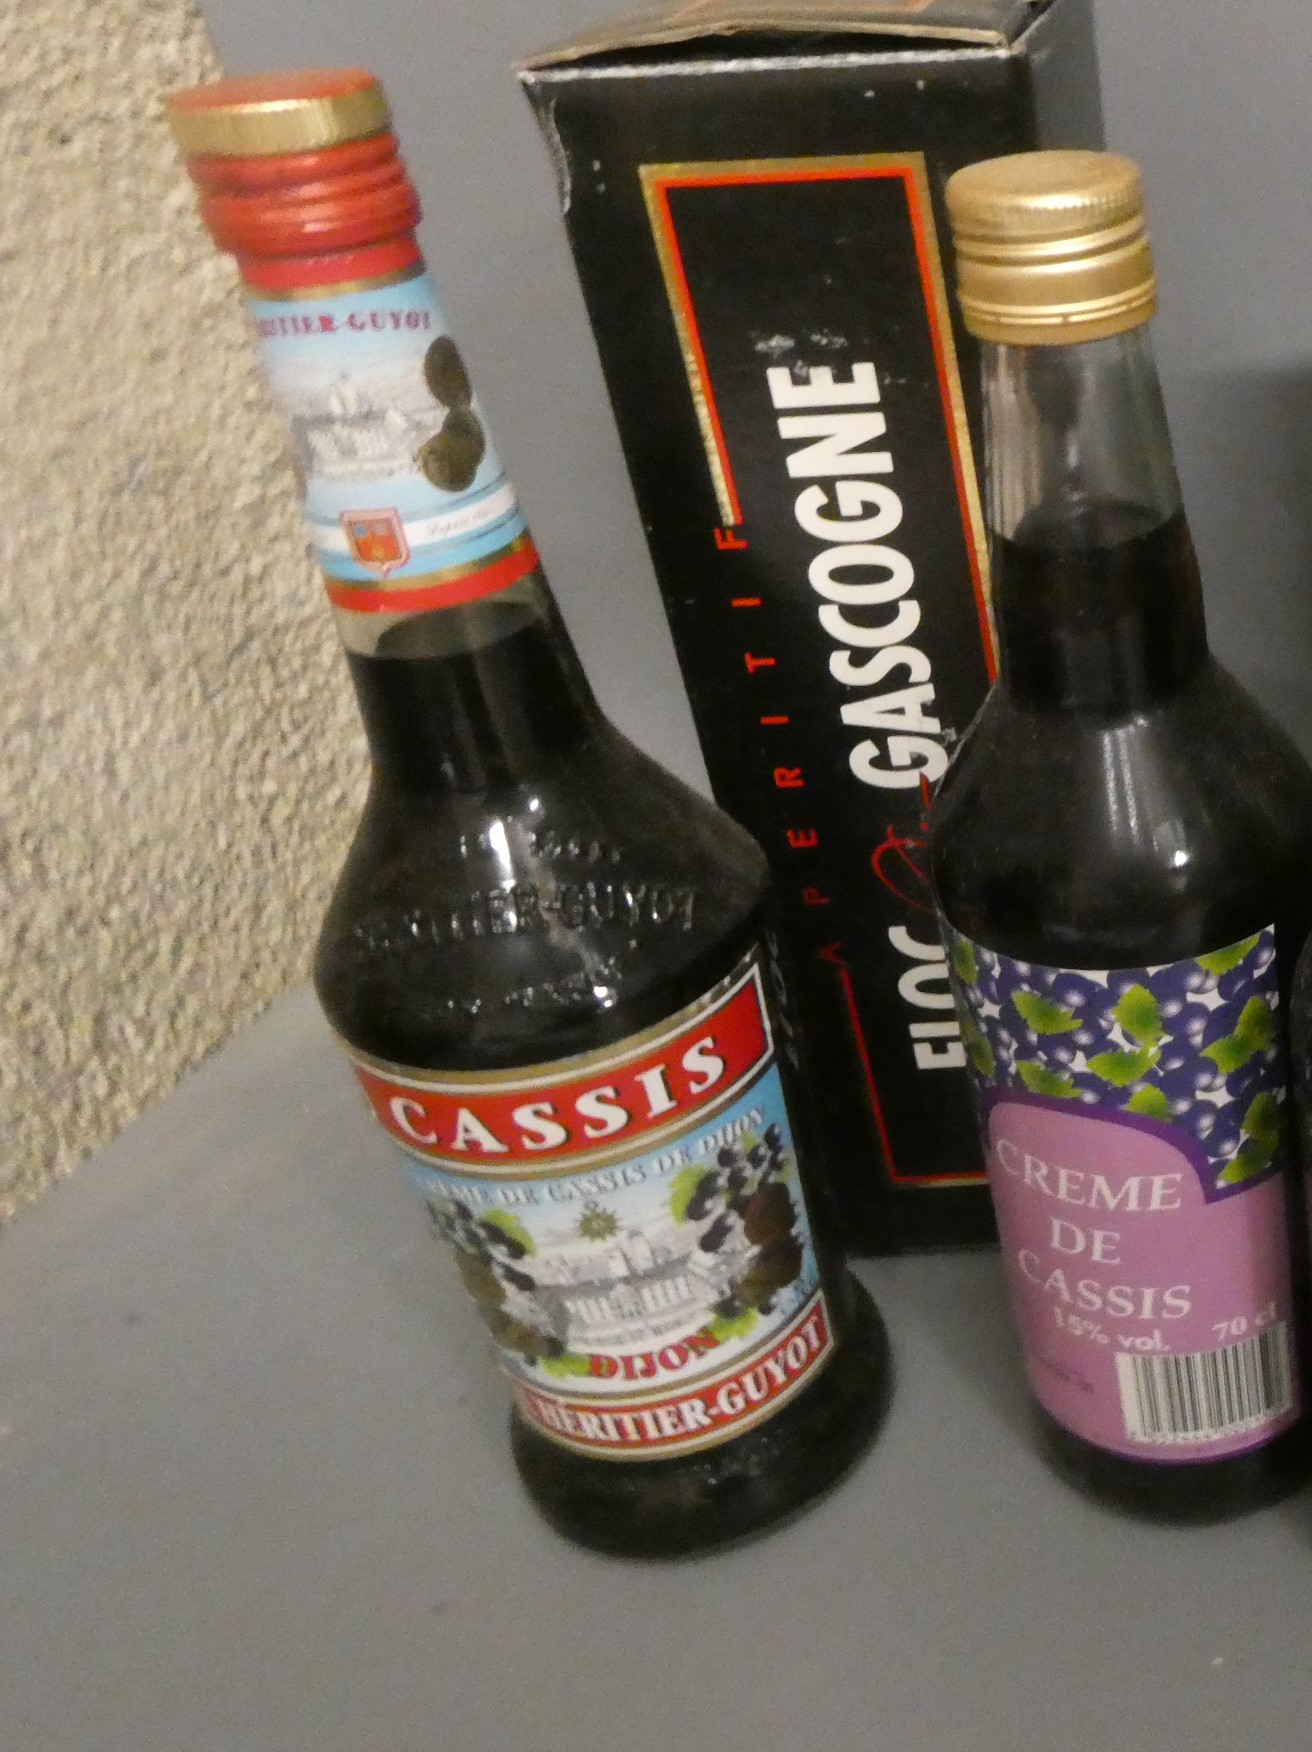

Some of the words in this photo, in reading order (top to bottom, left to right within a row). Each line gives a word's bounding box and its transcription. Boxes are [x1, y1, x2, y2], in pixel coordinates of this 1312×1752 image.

[765, 360, 949, 791] GASCOGNE
[390, 1035, 726, 1153] CASSIS
[995, 1138, 1182, 1212] CREME
[1049, 1215, 1122, 1265] DE
[1018, 1249, 1193, 1321] CASSIS
[589, 1327, 721, 1381] DIJON
[1053, 1306, 1109, 1345] 15%
[1211, 1315, 1248, 1341] 70
